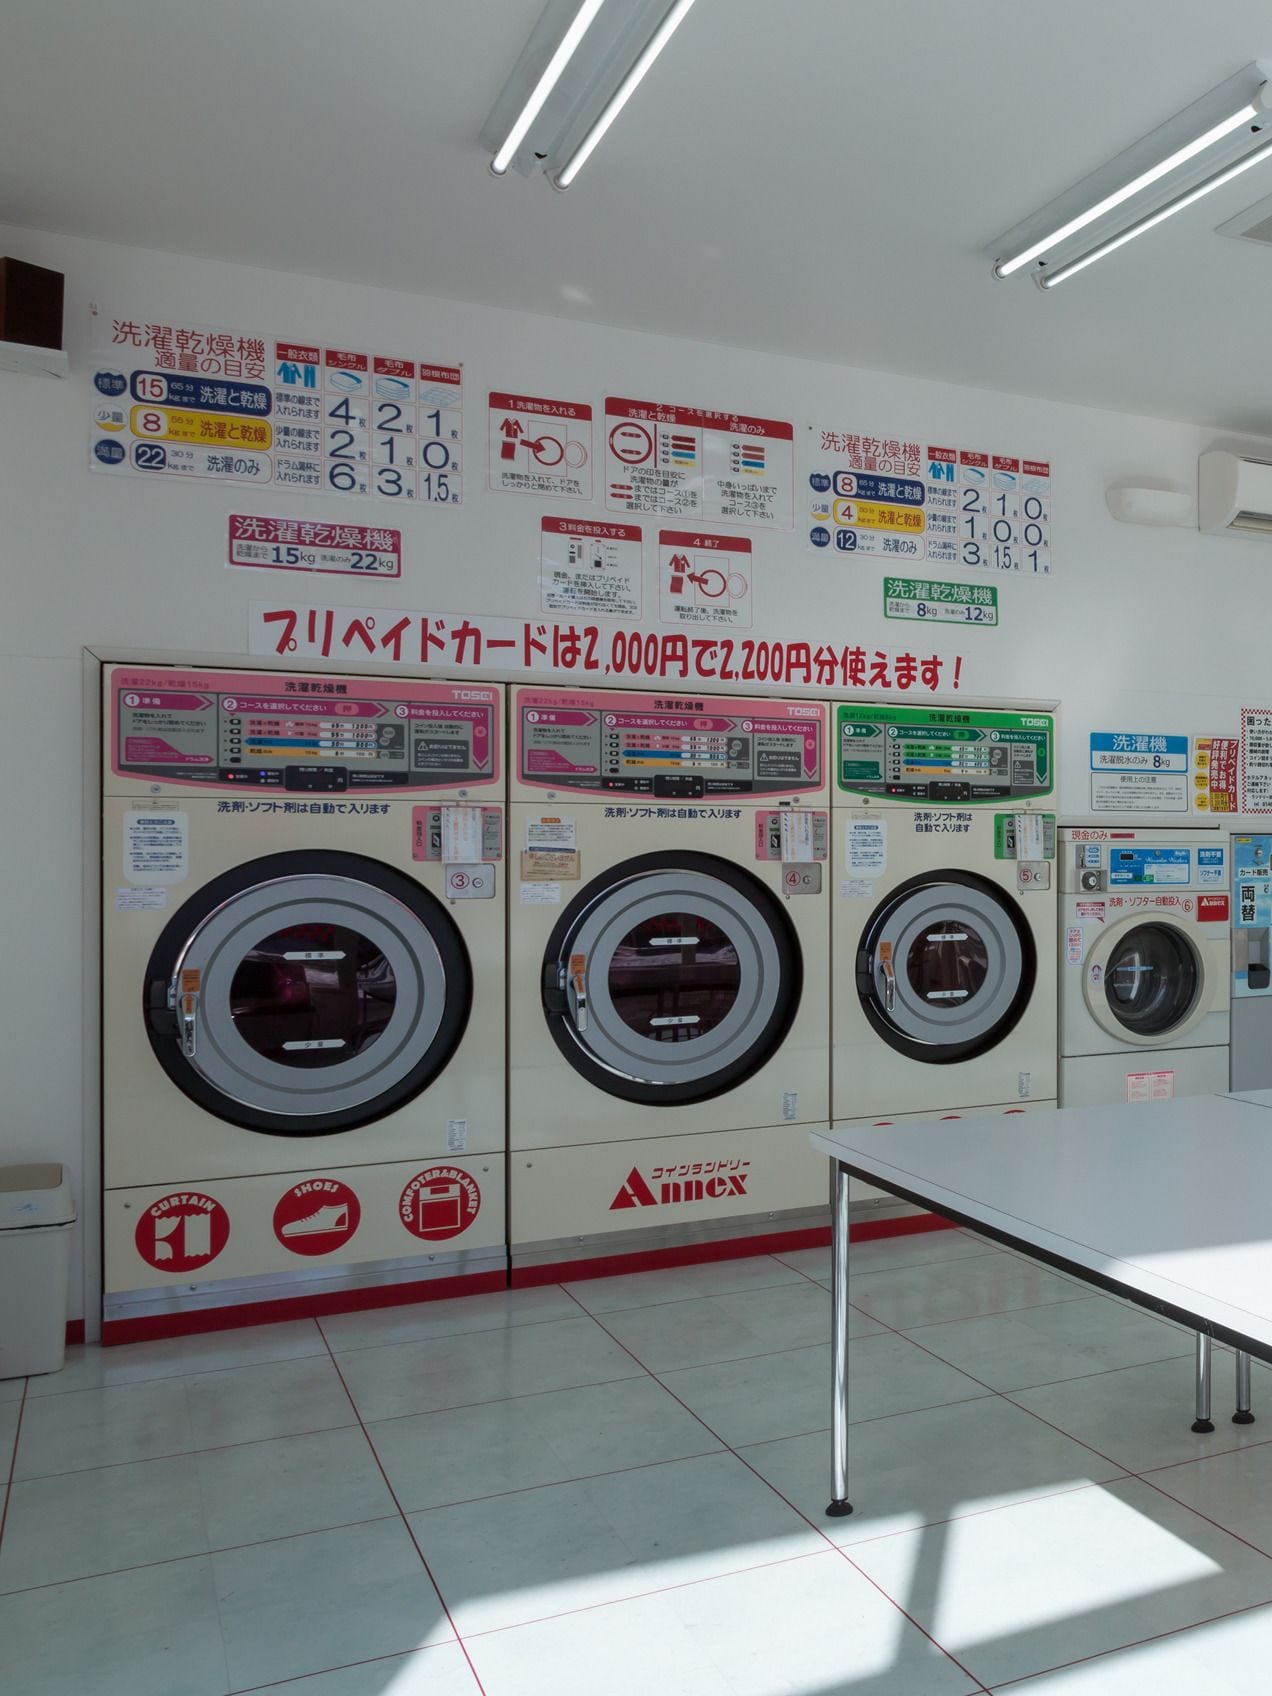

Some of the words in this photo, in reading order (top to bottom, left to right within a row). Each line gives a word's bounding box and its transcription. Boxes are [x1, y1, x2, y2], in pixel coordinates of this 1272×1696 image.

[112, 319, 265, 362] 洗濯乾燥機
[155, 350, 265, 380] 適量の目安
[139, 378, 163, 397] 15
[201, 385, 267, 409] 洗濯と乾燥
[517, 401, 576, 416] 洗濯物を入れる
[629, 409, 676, 423] 洗濯と乾燥
[143, 413, 160, 432] 8
[730, 423, 765, 435] 洗濯のみ
[201, 420, 267, 442] 洗濯と乾燥
[821, 431, 920, 463] 洗濯乾燥機
[138, 447, 164, 467] 22
[208, 455, 260, 475] 洗濯のみ
[849, 455, 920, 477] 適量の目安
[842, 477, 853, 492] 8
[879, 482, 922, 500] 洗濯と乾燥
[842, 505, 853, 519] 4
[879, 510, 921, 527] 洗濯と乾燥
[235, 518, 392, 551] 洗濯乾燥機
[568, 525, 625, 537] 料金を投入する
[705, 539, 719, 547] 終了
[838, 533, 854, 548] 12
[883, 538, 917, 554] 洗濯のみ
[272, 545, 315, 565] 15kg
[887, 580, 992, 605] 洗濯乾燥機
[917, 603, 937, 617] 8kg
[285, 682, 347, 694] 洗濯乾燥機
[452, 690, 492, 700] TOSEI
[239, 702, 327, 712] コースを選択してください
[654, 699, 704, 711] 洗濯乾燥機
[787, 707, 820, 716] TOSEI
[411, 709, 483, 718] 料金を投入してください
[929, 714, 970, 723] 洗濯乾燥機
[618, 717, 688, 727] コースを選択してください
[1020, 718, 1048, 726] TOSEI
[1113, 736, 1167, 753] 洗濯機
[1100, 755, 1148, 765] 洗濯脱水のみ
[1153, 755, 1170, 768] 8kg
[1219, 740, 1228, 790] 便利でお得
[1228, 740, 1239, 810] プリペイドカード
[217, 801, 390, 815] 洗剤・ソフト剤は自動で入ります
[604, 807, 742, 819] 洗剤・ソフト剤は自動で入ります
[914, 813, 972, 822] 洗剤・ソフト剤は
[915, 824, 970, 832] 自動で入ります
[1072, 831, 1108, 840] 現金のみ
[1242, 885, 1255, 922] 両替
[651, 1160, 750, 1179] コインランドリー
[294, 1179, 340, 1197] SHOES
[609, 1166, 748, 1210] Annex
[150, 1194, 216, 1217] CURTAIN
